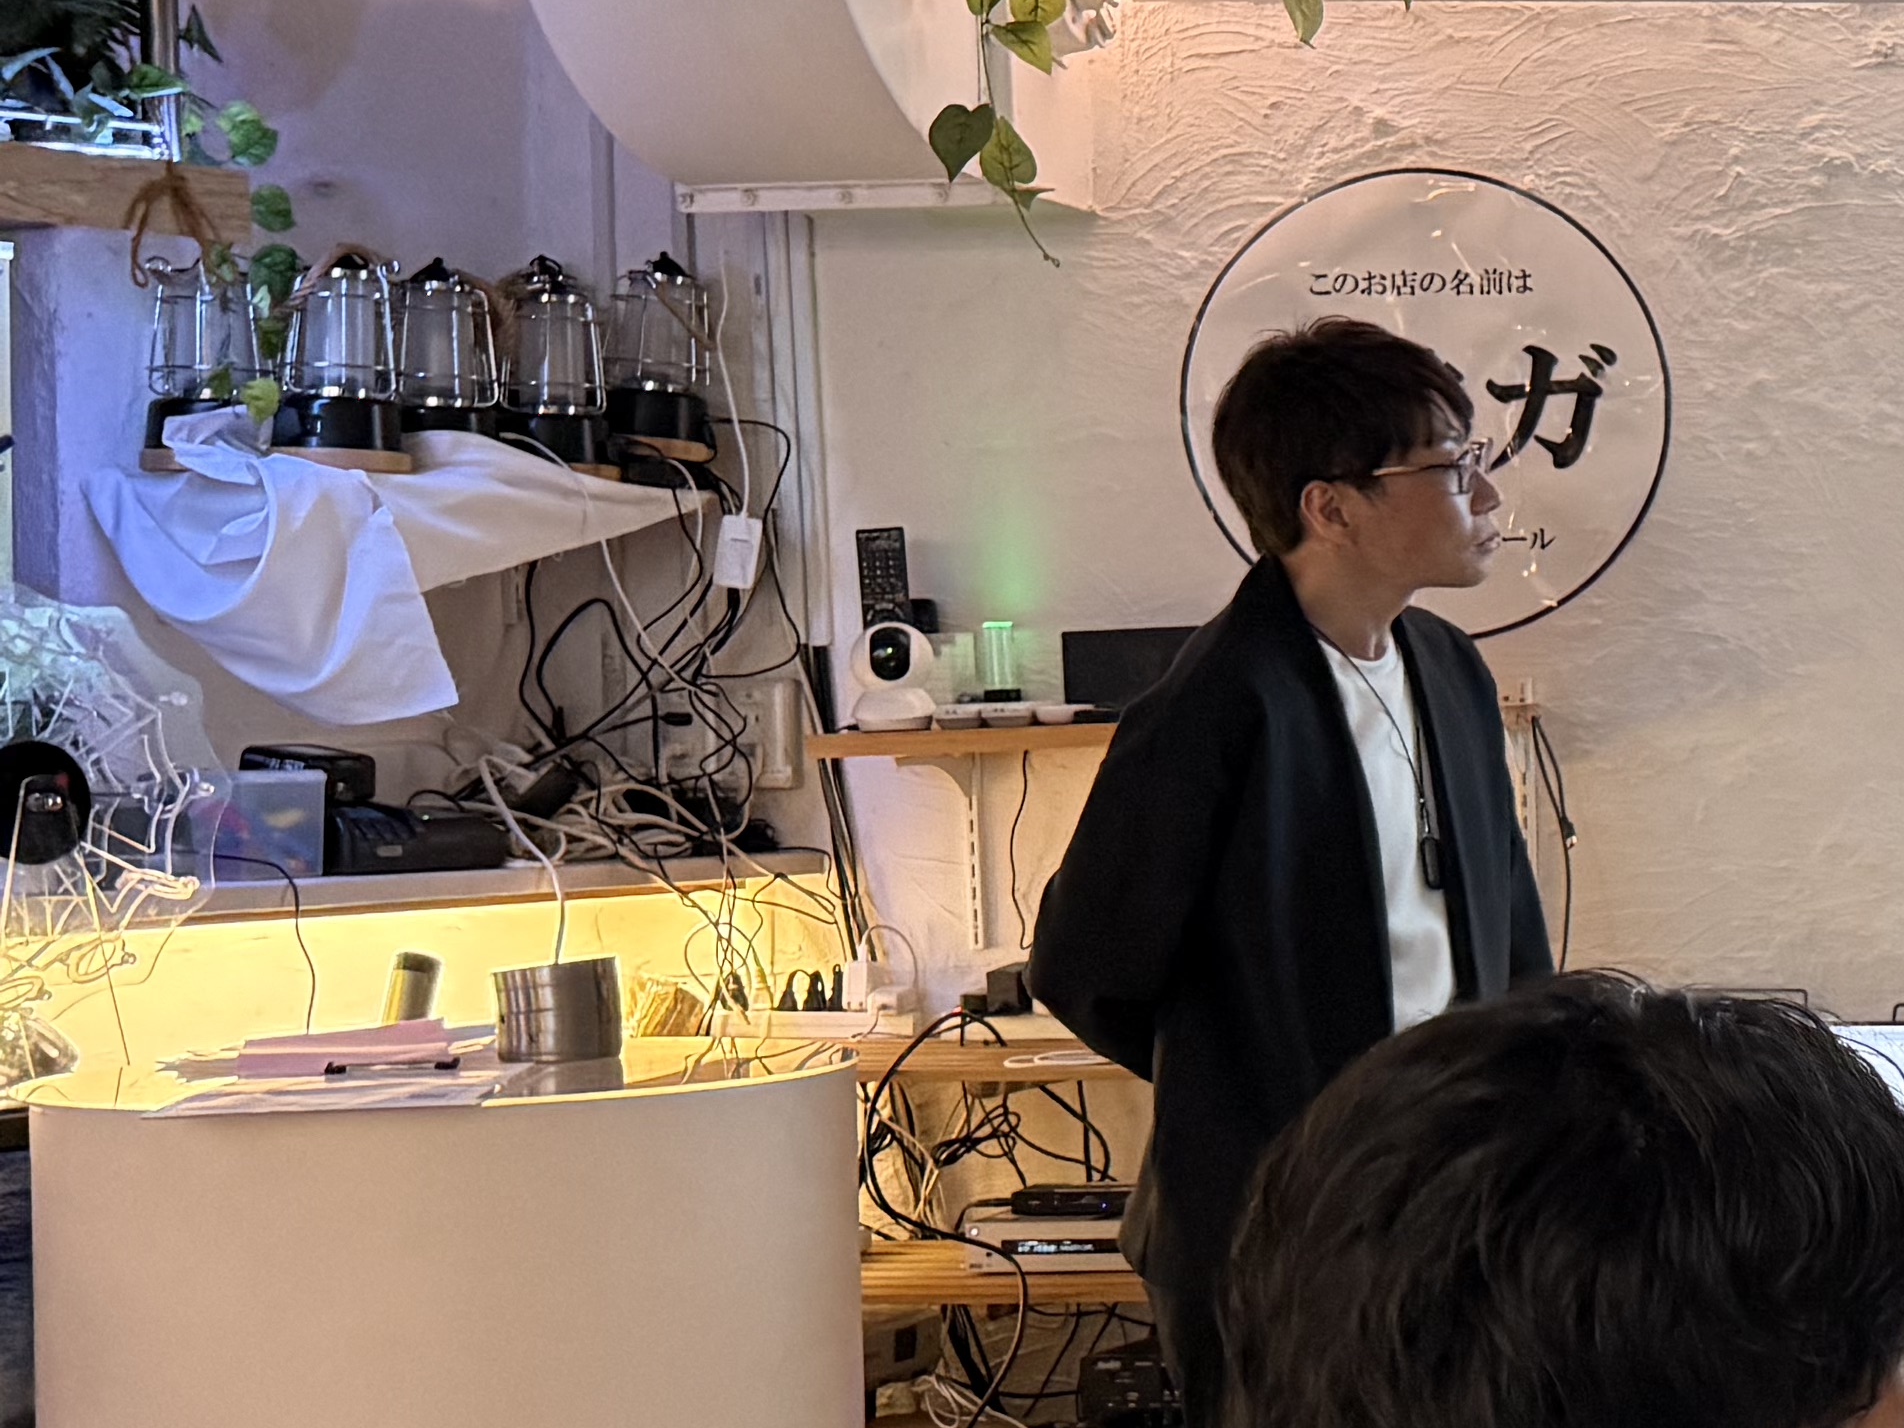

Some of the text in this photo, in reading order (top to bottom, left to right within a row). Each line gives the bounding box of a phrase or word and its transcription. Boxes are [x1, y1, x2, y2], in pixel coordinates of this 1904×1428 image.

[1309, 269, 1533, 296] このお店の名前は
[1486, 343, 1618, 471] ガ
[1501, 527, 1556, 551] ール
